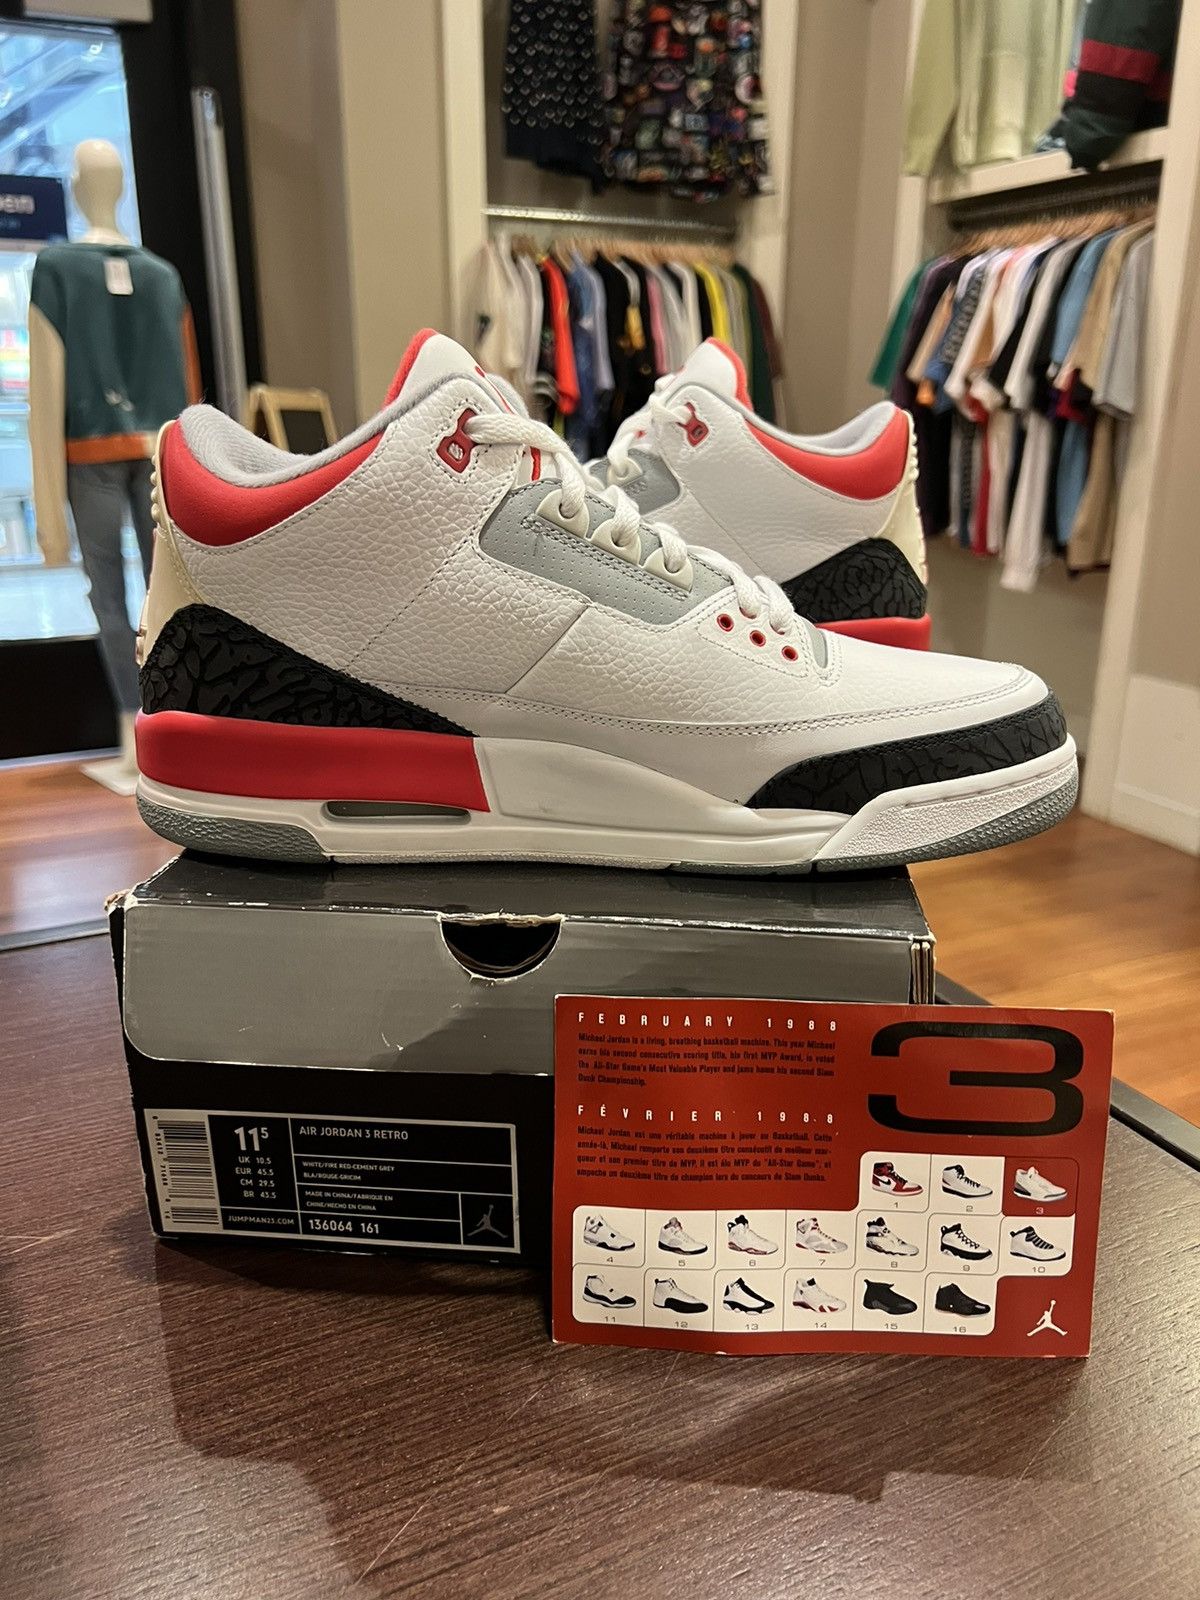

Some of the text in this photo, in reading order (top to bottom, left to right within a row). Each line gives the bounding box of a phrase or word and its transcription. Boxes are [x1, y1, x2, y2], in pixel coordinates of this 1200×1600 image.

[578, 1012, 836, 1032] FEBRUARY 1988
[578, 1032, 605, 1042] Michael
[606, 1033, 630, 1044] Jordan
[632, 1034, 638, 1044] is
[646, 1036, 666, 1046] living,
[668, 1036, 702, 1046] breathing
[704, 1037, 738, 1046] basketball
[740, 1038, 770, 1046] machine.
[774, 1038, 788, 1047] This
[790, 1041, 804, 1049] year
[806, 1040, 836, 1050] Michael
[578, 1048, 597, 1056] earns
[599, 1048, 610, 1056] his
[612, 1050, 637, 1058] second
[640, 1050, 680, 1058] consecutive
[683, 1051, 708, 1060] scoring
[711, 1051, 727, 1060] title,
[730, 1051, 740, 1059] his
[743, 1051, 758, 1060] first
[780, 1053, 803, 1062] Award,
[806, 1054, 812, 1062] is
[816, 1054, 835, 1064] voted
[578, 1060, 834, 1076] the All-Star Game's Most Valuable Player and jams home his second Slam
[578, 1073, 646, 1087] Dunk Championship.
[868, 1020, 1084, 1136] 3
[577, 1104, 833, 1124] FÉVRIER 1988
[298, 1126, 408, 1140] AIR JORDAN 3 RETRO
[238, 1156, 272, 1165] UK 10.5
[235, 1166, 274, 1176] EUR 45.5
[240, 1178, 276, 1188] CM 29.5
[306, 1200, 347, 1209] CHINE/HECHO
[228, 1215, 295, 1226] JUMPMAN23.COM
[308, 1218, 380, 1234] 136064 161
